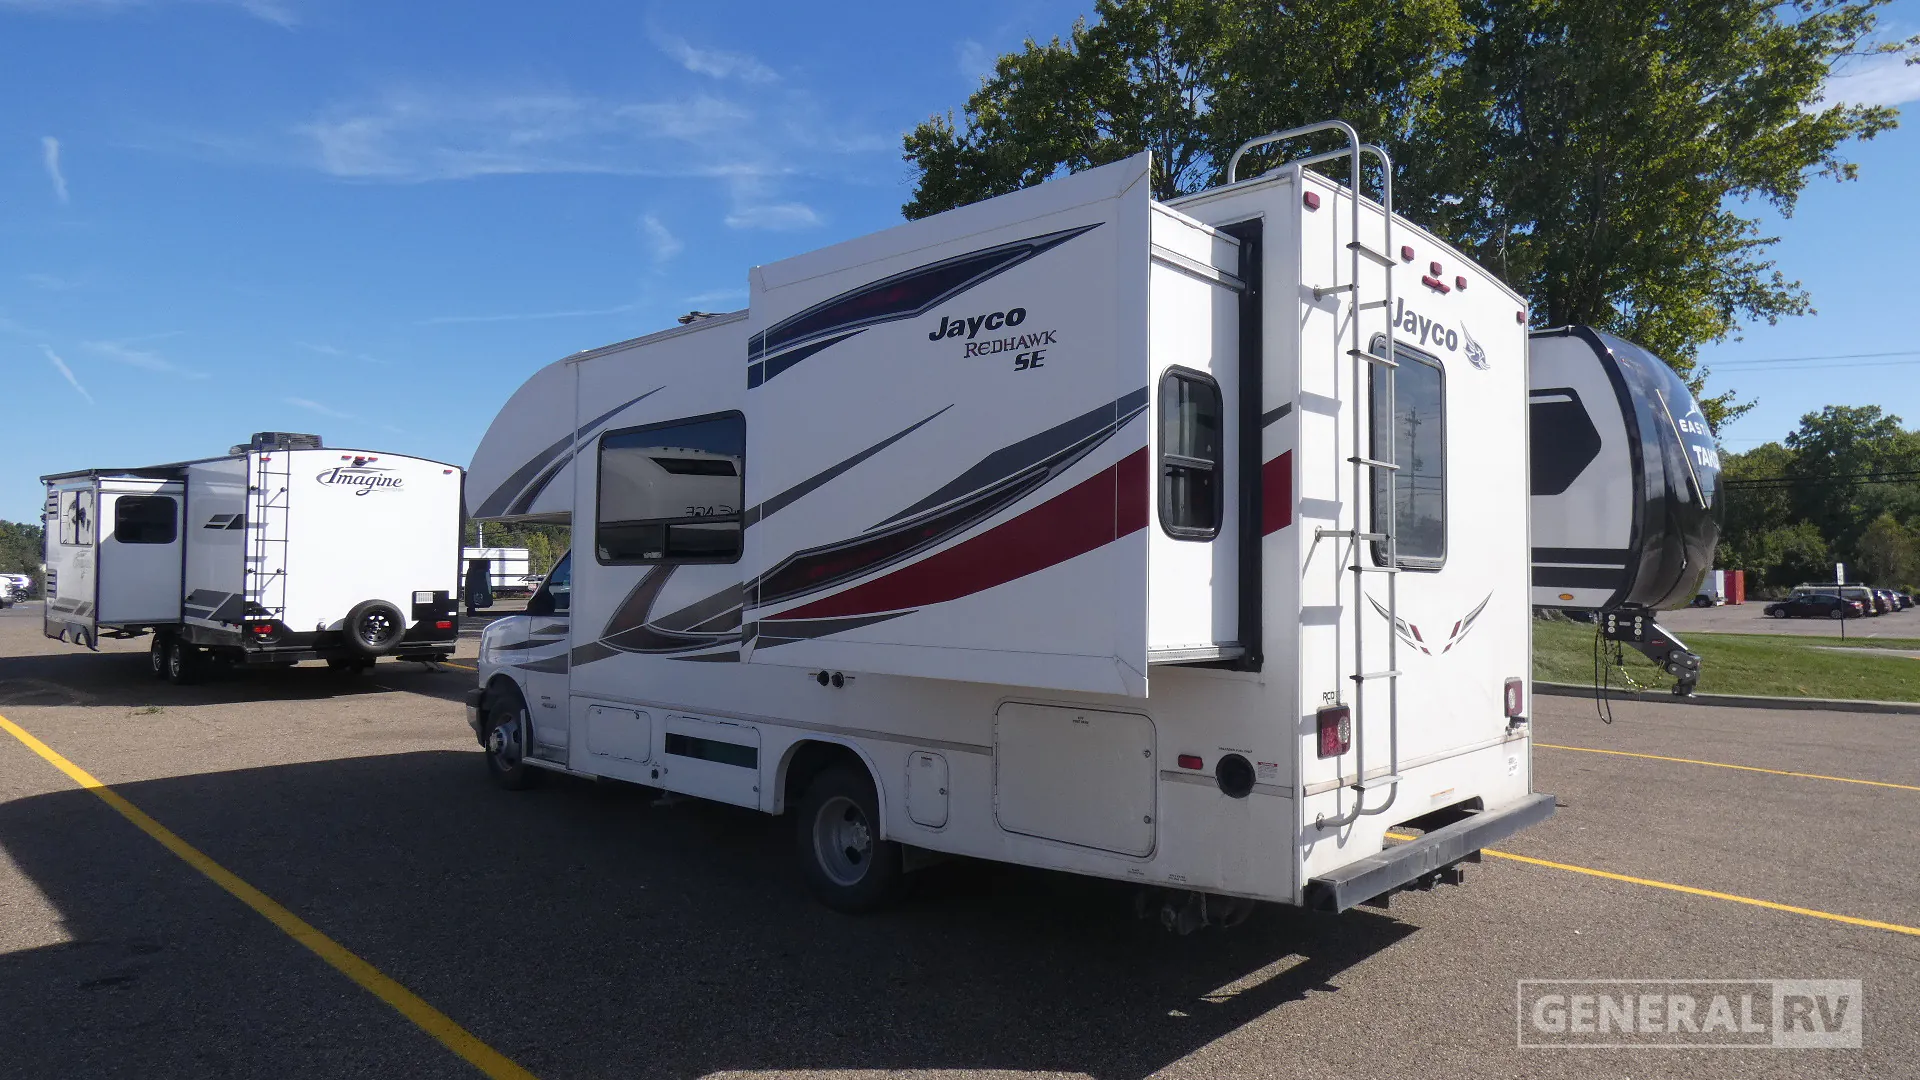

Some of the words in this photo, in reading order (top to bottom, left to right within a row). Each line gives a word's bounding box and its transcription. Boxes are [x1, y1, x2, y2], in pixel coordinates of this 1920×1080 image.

[928, 307, 1027, 341] Jayco
[1392, 296, 1458, 352] Jayco
[1013, 349, 1047, 371] SE
[325, 466, 404, 496] Imagine
